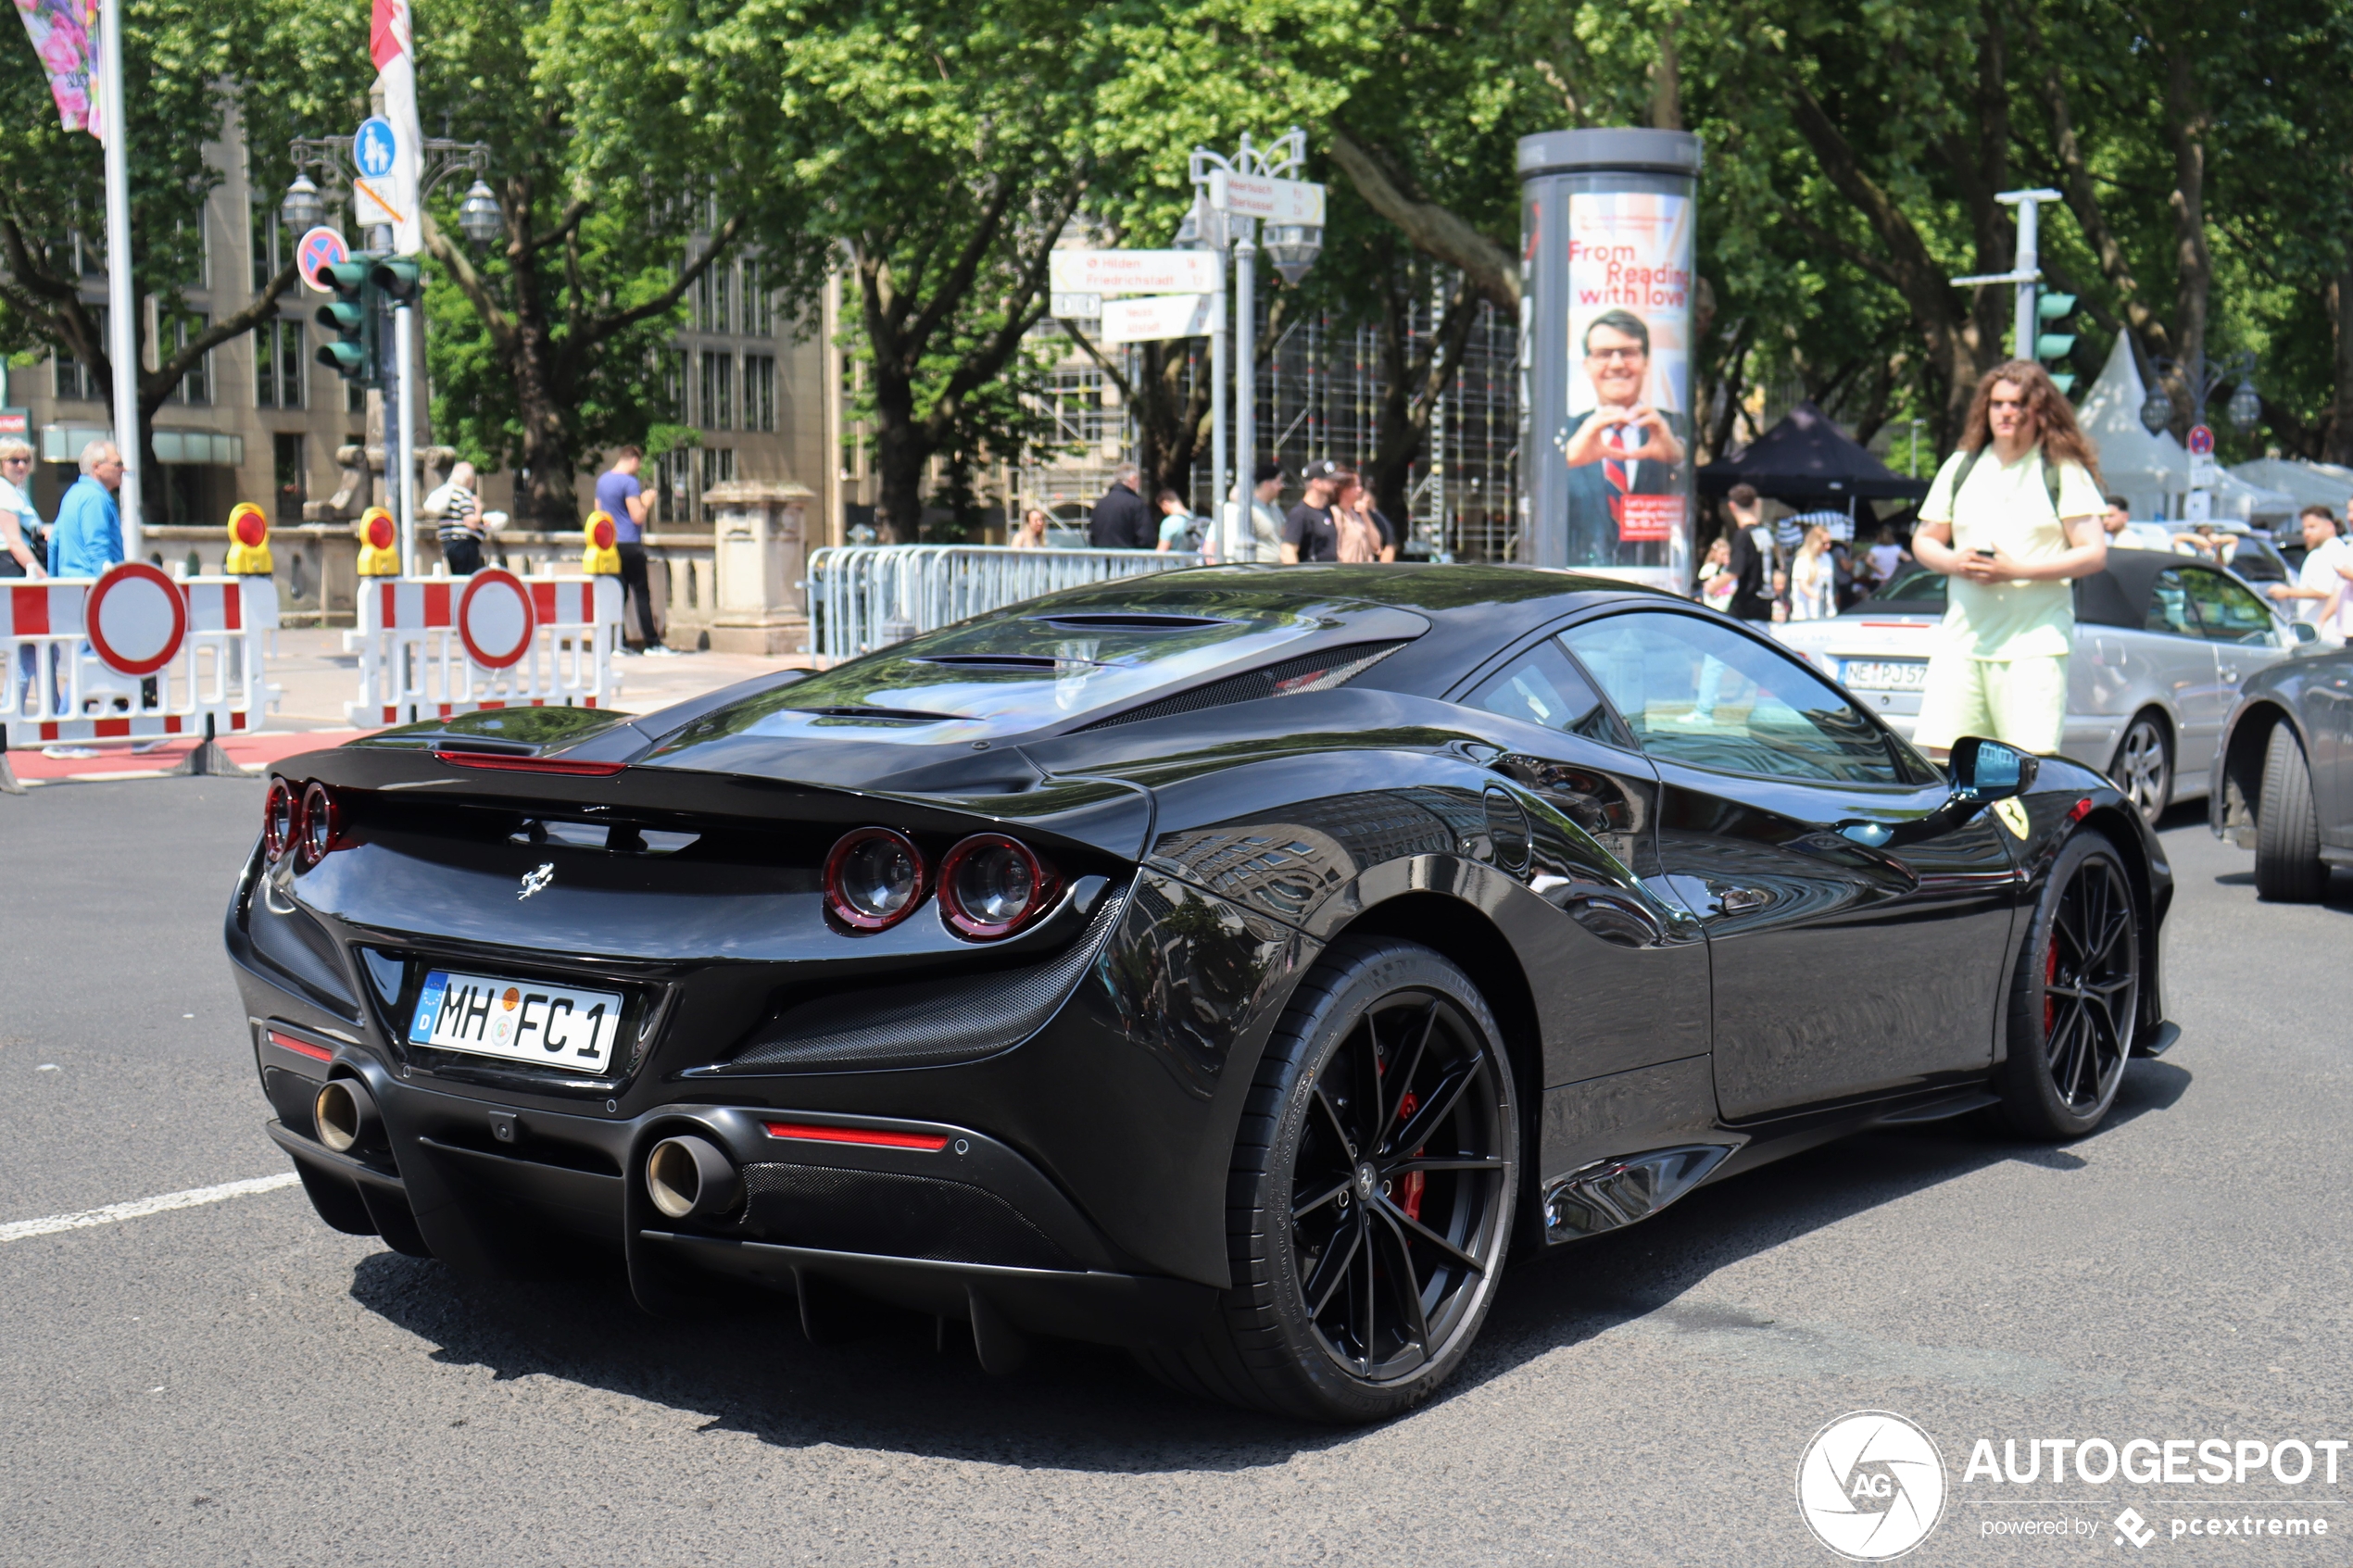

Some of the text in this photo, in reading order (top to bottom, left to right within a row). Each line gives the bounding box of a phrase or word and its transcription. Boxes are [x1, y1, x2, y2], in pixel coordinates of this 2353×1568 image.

[1568, 240, 1635, 262] From
[1101, 257, 1141, 270] Hilden
[1086, 273, 1176, 286] Friedrichstadt
[1579, 282, 1637, 305] with
[1848, 663, 1869, 681] NE
[434, 982, 496, 1041] MH
